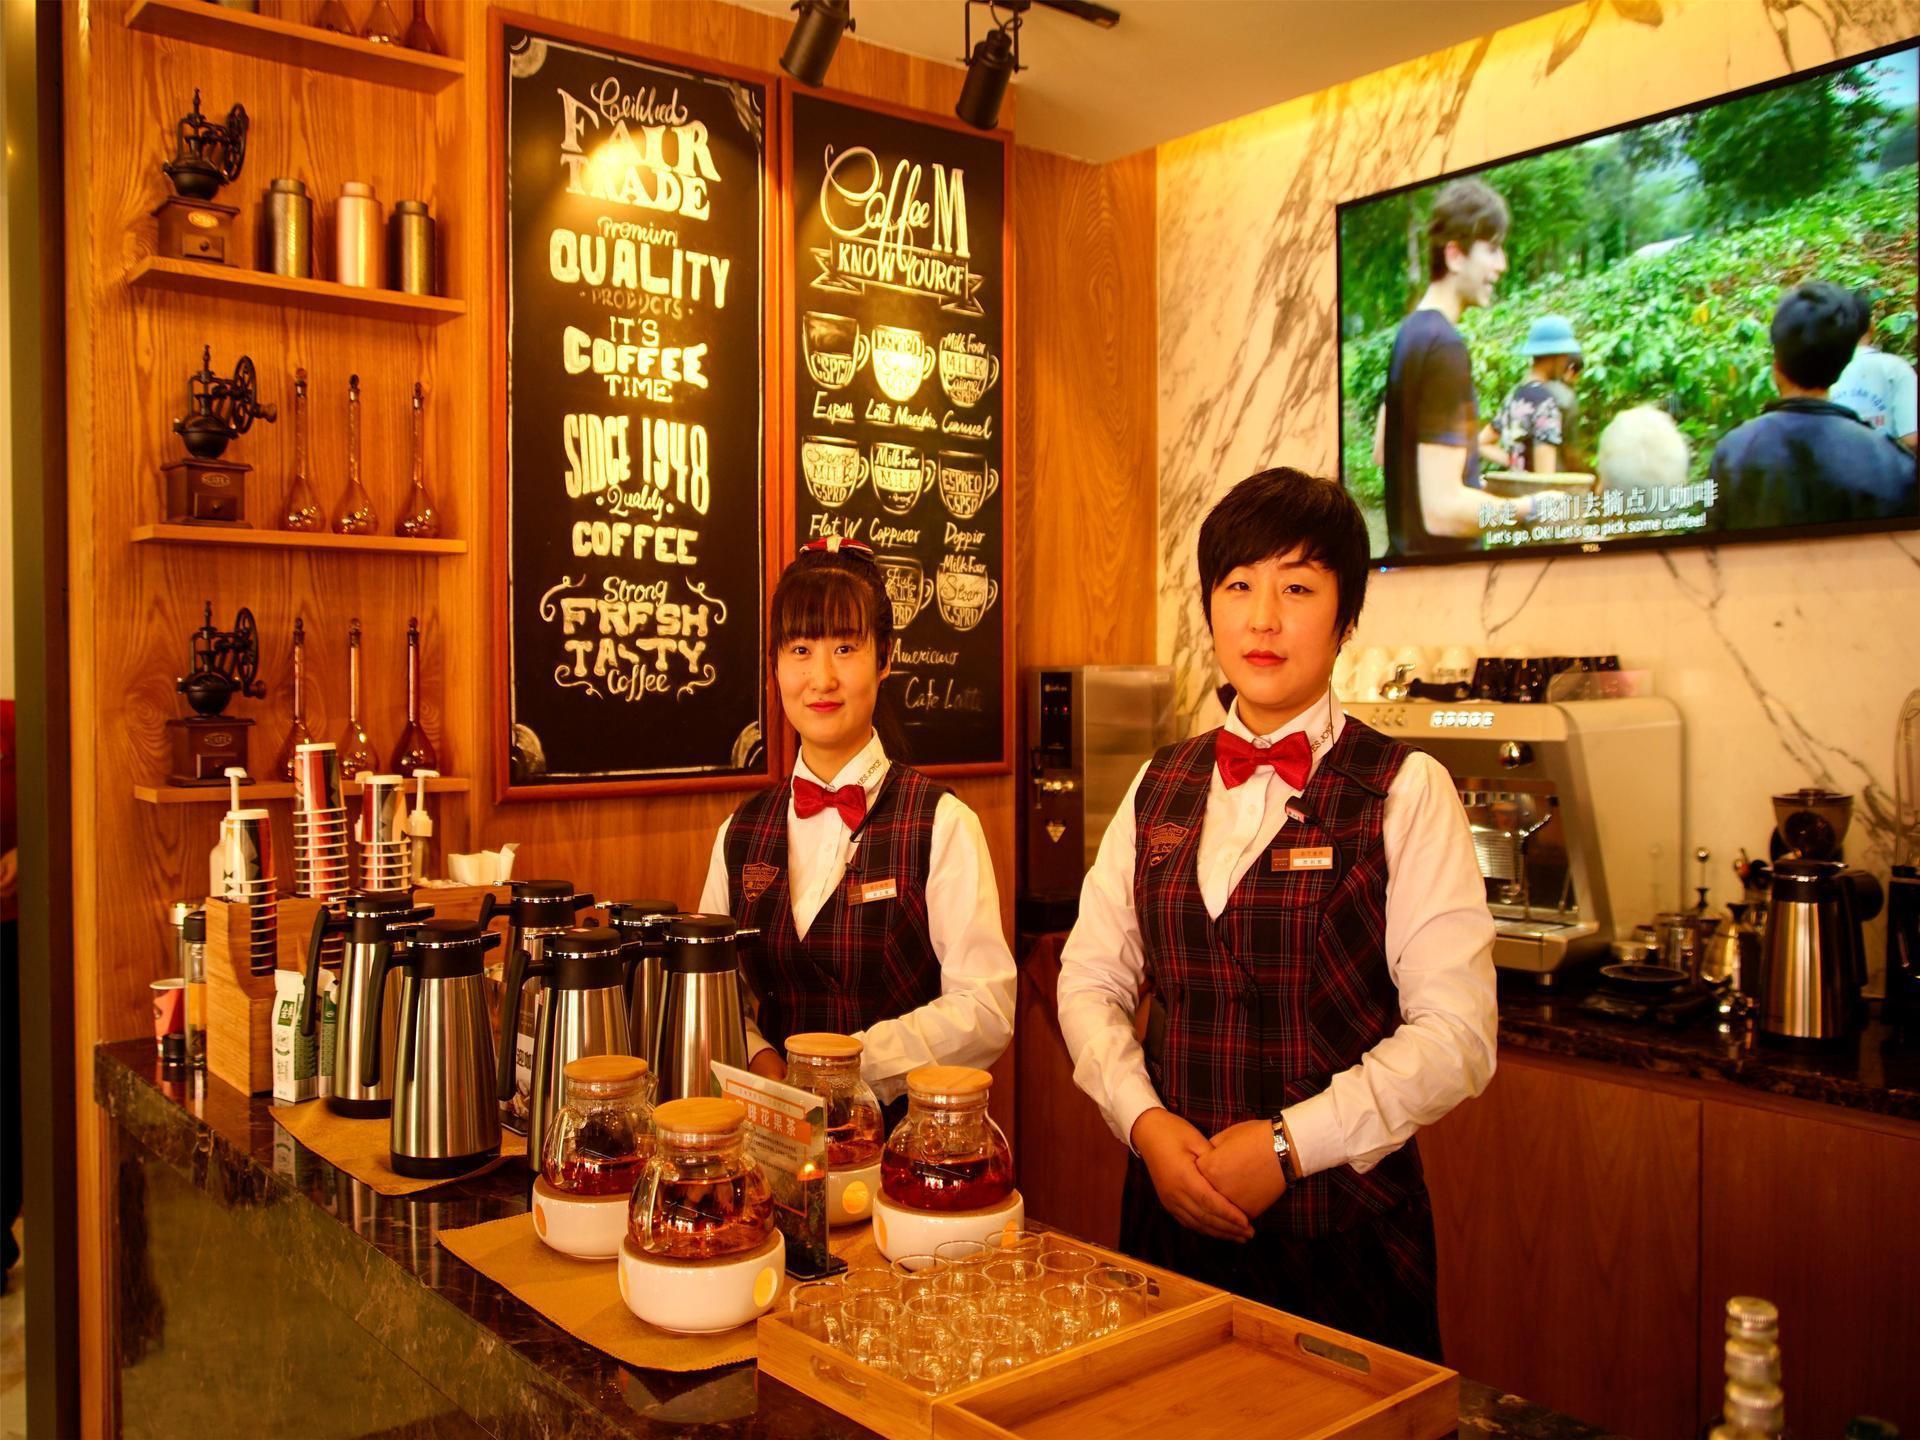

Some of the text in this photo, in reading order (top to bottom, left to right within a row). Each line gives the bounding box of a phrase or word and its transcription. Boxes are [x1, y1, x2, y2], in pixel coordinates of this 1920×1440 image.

[557, 88, 721, 182] FAIR
[560, 153, 710, 221] TRADE
[820, 144, 930, 272] Coffee
[550, 229, 730, 308] QUALITY
[837, 242, 895, 282] KNOW
[591, 289, 682, 320] PRODUCTS
[609, 316, 659, 347] IT'S
[563, 326, 709, 389] COFFEE
[604, 374, 673, 403] TIME
[641, 417, 709, 515] 1948
[572, 522, 698, 565] COFFEE
[810, 513, 840, 537] Flat
[945, 522, 985, 551] Doppio
[1628, 518, 1661, 532] some
[603, 576, 668, 606] Strong
[607, 665, 670, 702] Coffee
